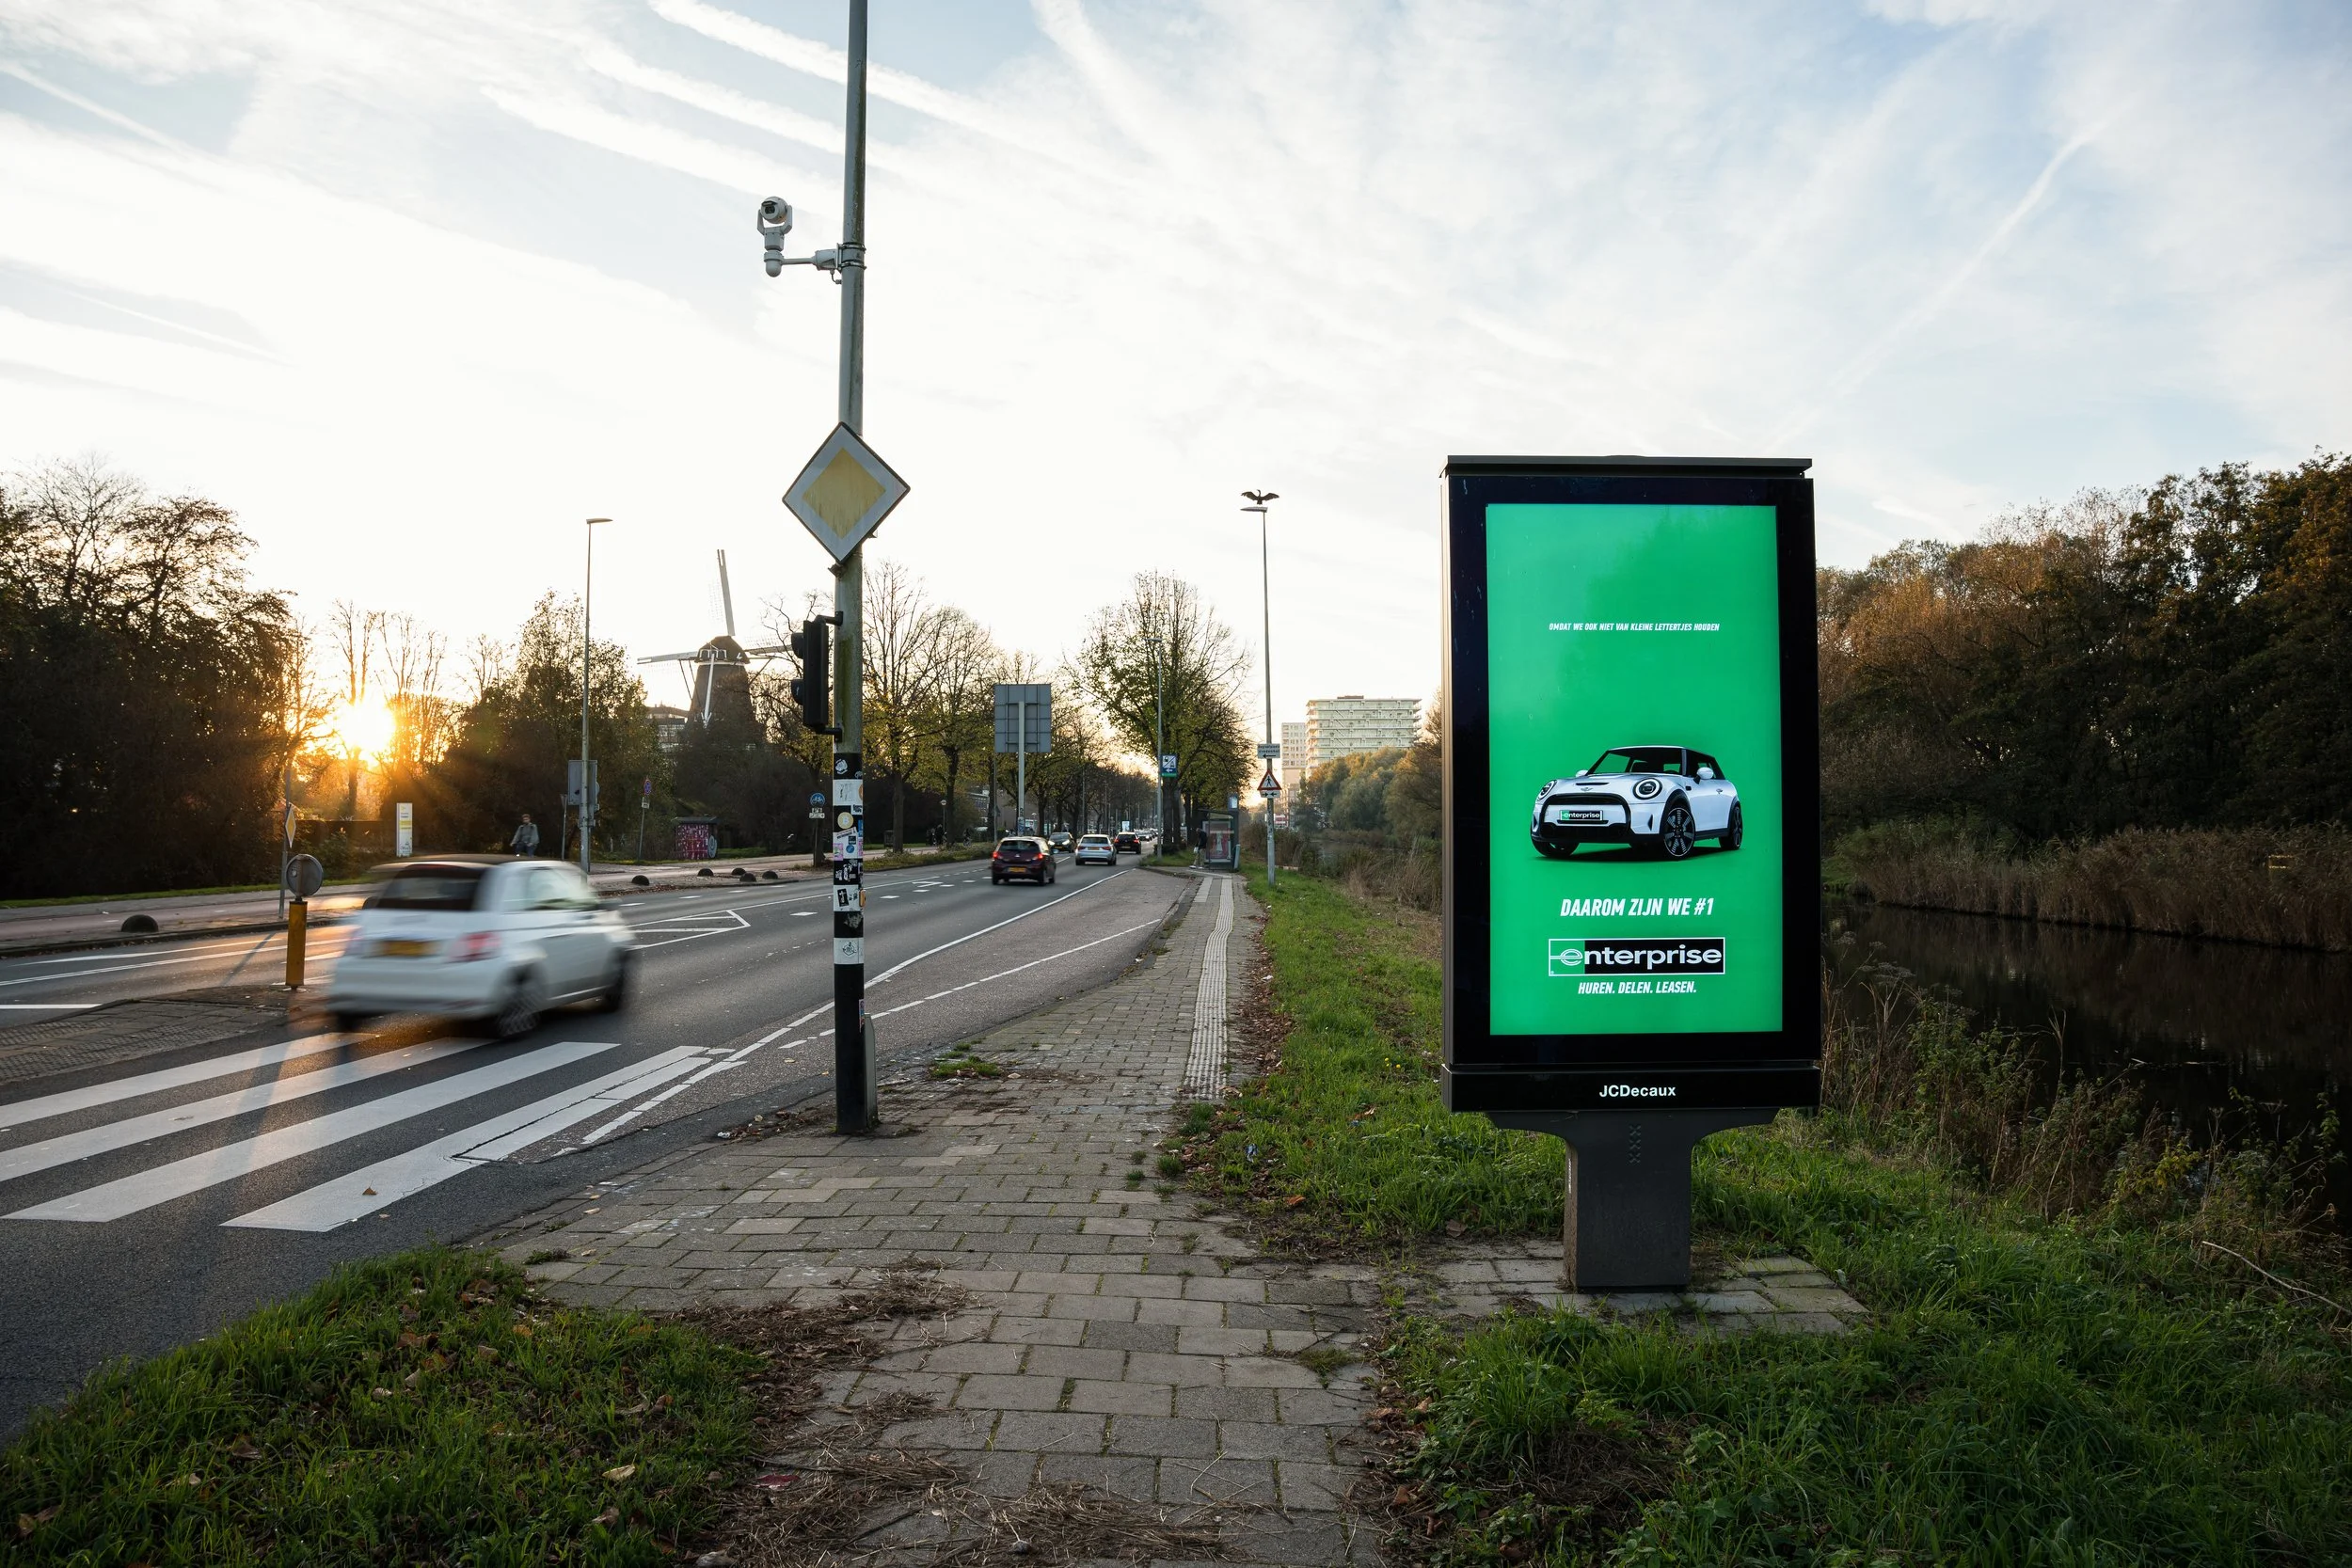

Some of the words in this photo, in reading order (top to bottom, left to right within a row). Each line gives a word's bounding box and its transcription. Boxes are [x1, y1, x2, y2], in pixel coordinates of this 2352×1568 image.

[1549, 622, 1571, 631] OMDAT
[1573, 622, 1583, 631] WE
[1584, 622, 1597, 631] OOK
[1599, 622, 1614, 631] NIET
[1616, 622, 1629, 631] VAN
[1630, 622, 1653, 631] KLEINE
[1655, 622, 1692, 631] LETTERTJES
[1693, 622, 1720, 631] HOUDEN
[1560, 898, 1626, 917] DAAROM
[1628, 898, 1663, 916] ZIJN
[1667, 897, 1692, 916] WE
[1693, 897, 1714, 915] #1
[1558, 943, 1723, 971] enterprise
[1578, 982, 1615, 994] HUREN.
[1617, 981, 1653, 994] DELEN.
[1655, 981, 1696, 993] LEASEN.
[1598, 1085, 1677, 1097] JCDecaux
